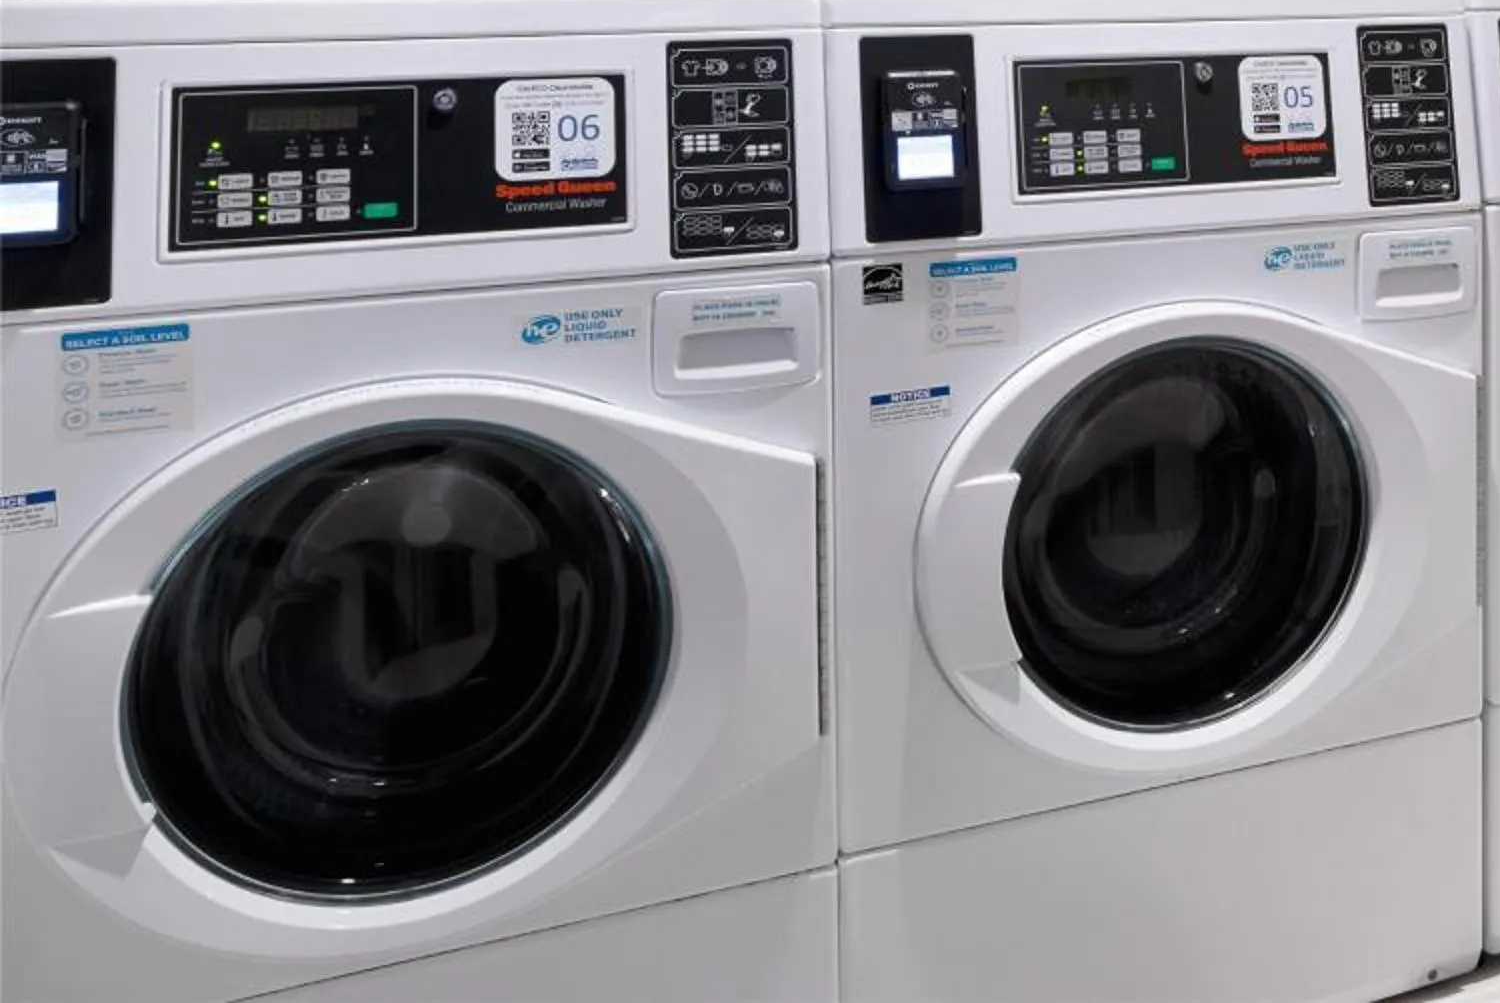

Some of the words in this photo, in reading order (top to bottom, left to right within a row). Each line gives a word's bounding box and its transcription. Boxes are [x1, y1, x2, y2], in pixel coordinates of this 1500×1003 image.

[1284, 85, 1313, 108] 05
[558, 114, 600, 141] 06
[496, 181, 555, 199] Speed
[558, 180, 617, 194] Queen
[505, 197, 567, 213] Commercial
[569, 197, 608, 209] Washer
[591, 309, 623, 319] ONLY
[65, 337, 108, 348] SELECT
[111, 335, 120, 344] A
[563, 328, 636, 342] DETERGENT
